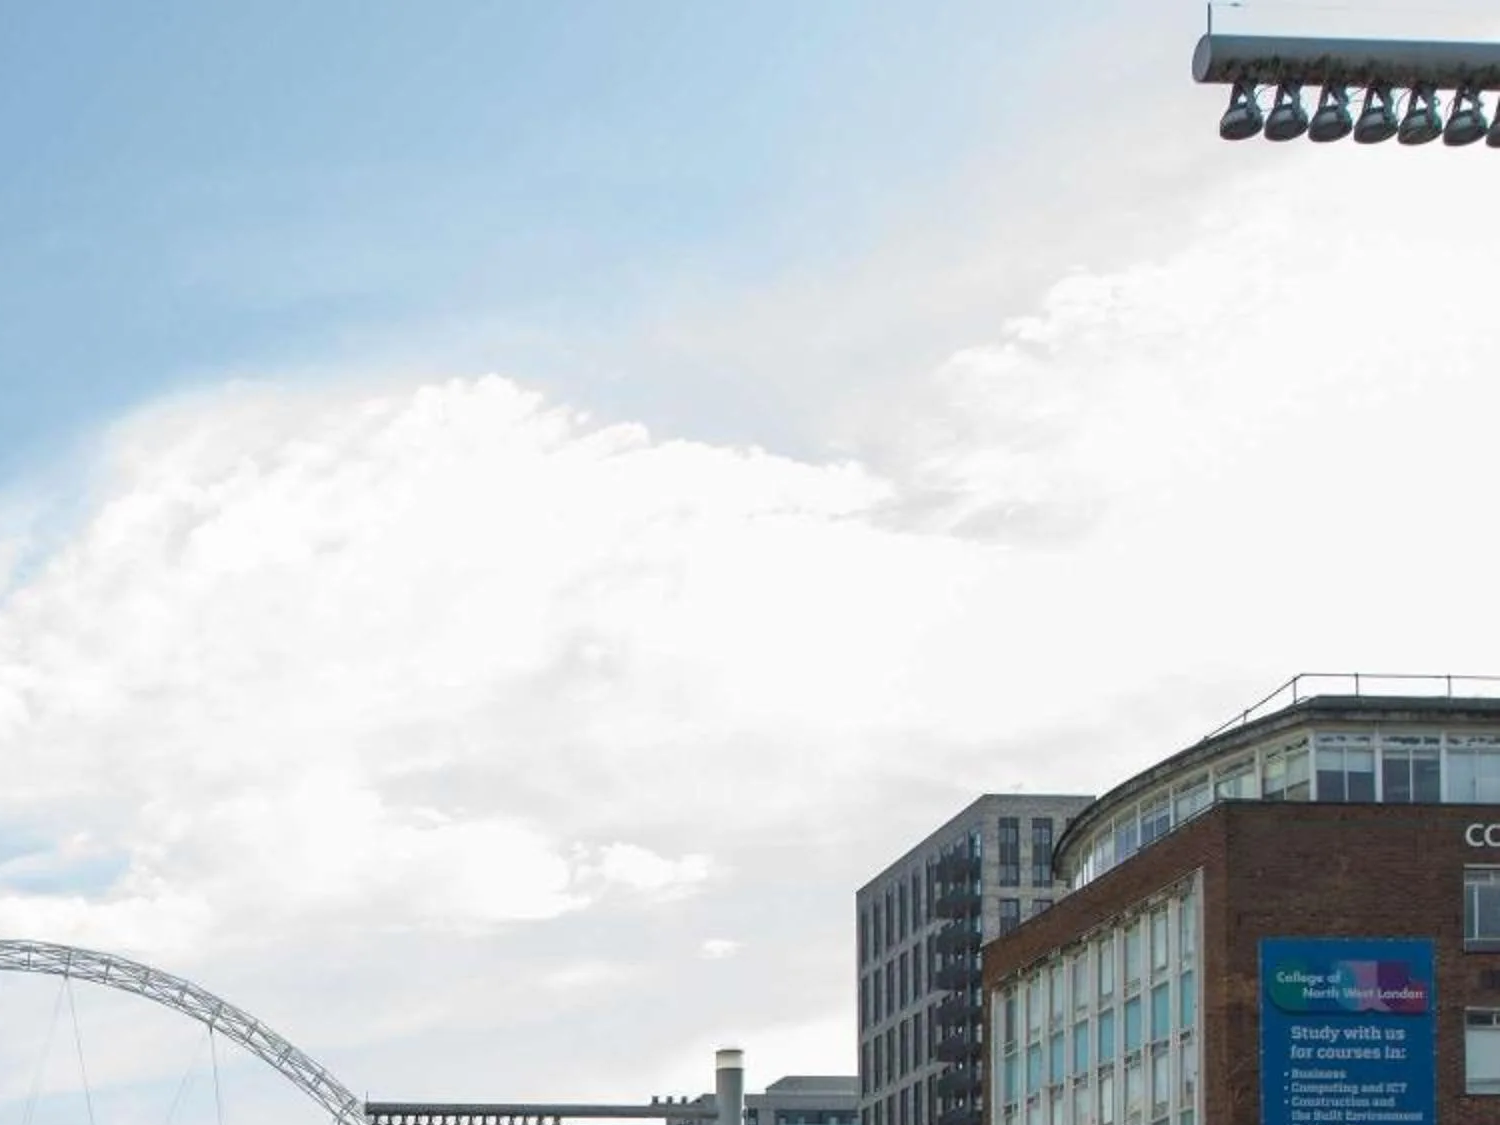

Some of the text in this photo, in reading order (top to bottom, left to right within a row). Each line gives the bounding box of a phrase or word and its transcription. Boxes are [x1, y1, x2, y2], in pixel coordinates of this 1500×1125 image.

[1276, 971, 1341, 986] College of
[1302, 987, 1424, 999] North West London
[1291, 1026, 1405, 1042] Study with us
[1290, 1046, 1407, 1059] for courses in:
[1291, 1069, 1347, 1079] Business
[1291, 1083, 1407, 1095] Computing and ICT
[1292, 1097, 1396, 1107] Construction and
[1313, 1111, 1343, 1121] Built
[1346, 1111, 1423, 1122] Environment
